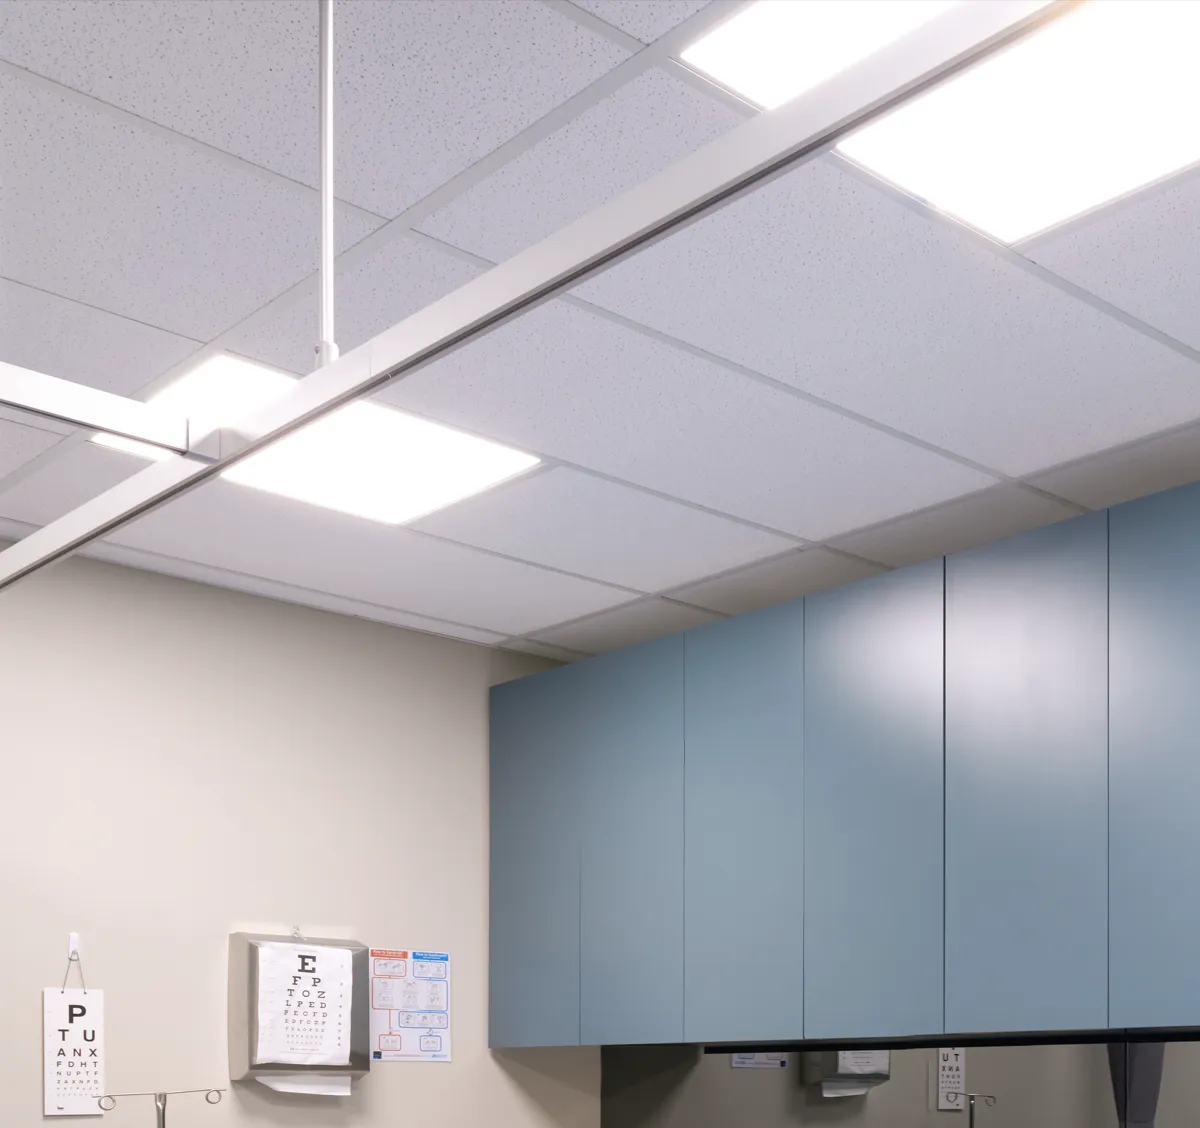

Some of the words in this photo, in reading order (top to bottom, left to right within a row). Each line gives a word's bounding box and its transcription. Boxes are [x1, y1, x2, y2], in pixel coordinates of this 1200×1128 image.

[298, 955, 316, 973] E
[292, 976, 301, 985] F
[312, 978, 321, 987] P
[68, 1005, 86, 1024] P
[58, 1029, 69, 1041] T
[83, 1030, 96, 1042] U
[57, 1048, 66, 1057] A
[73, 1048, 81, 1057] N
[89, 1048, 97, 1057] X
